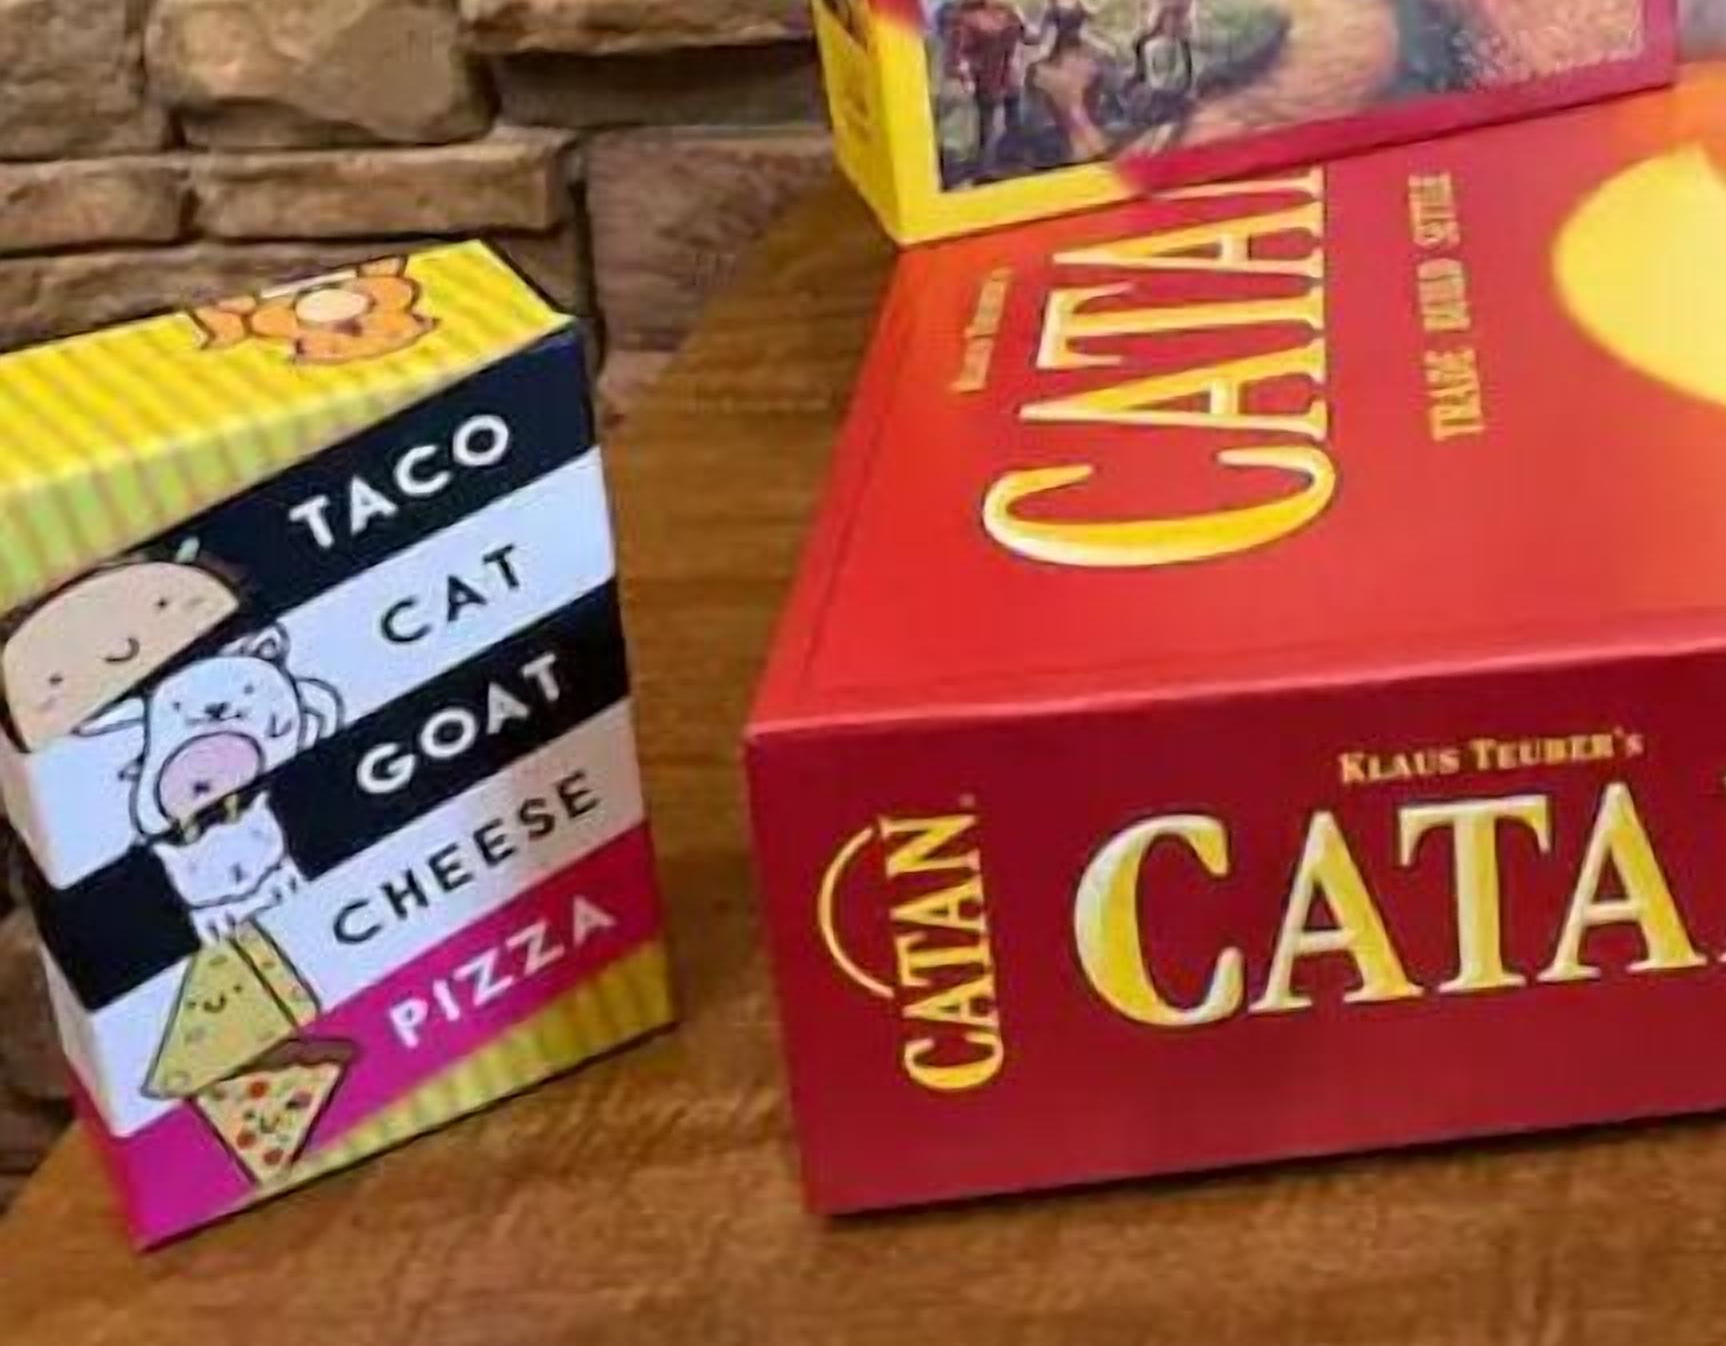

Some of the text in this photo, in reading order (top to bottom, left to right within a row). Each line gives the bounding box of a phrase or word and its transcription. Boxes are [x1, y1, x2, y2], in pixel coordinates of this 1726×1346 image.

[289, 415, 511, 550] TACO
[380, 544, 524, 644] CAT
[356, 654, 566, 796] GOAT
[1339, 726, 1644, 785] KLAUS TEUBER'S
[332, 772, 602, 945] CHEESE
[389, 897, 618, 1051] PIZZA
[877, 812, 1006, 1092] CATAN
